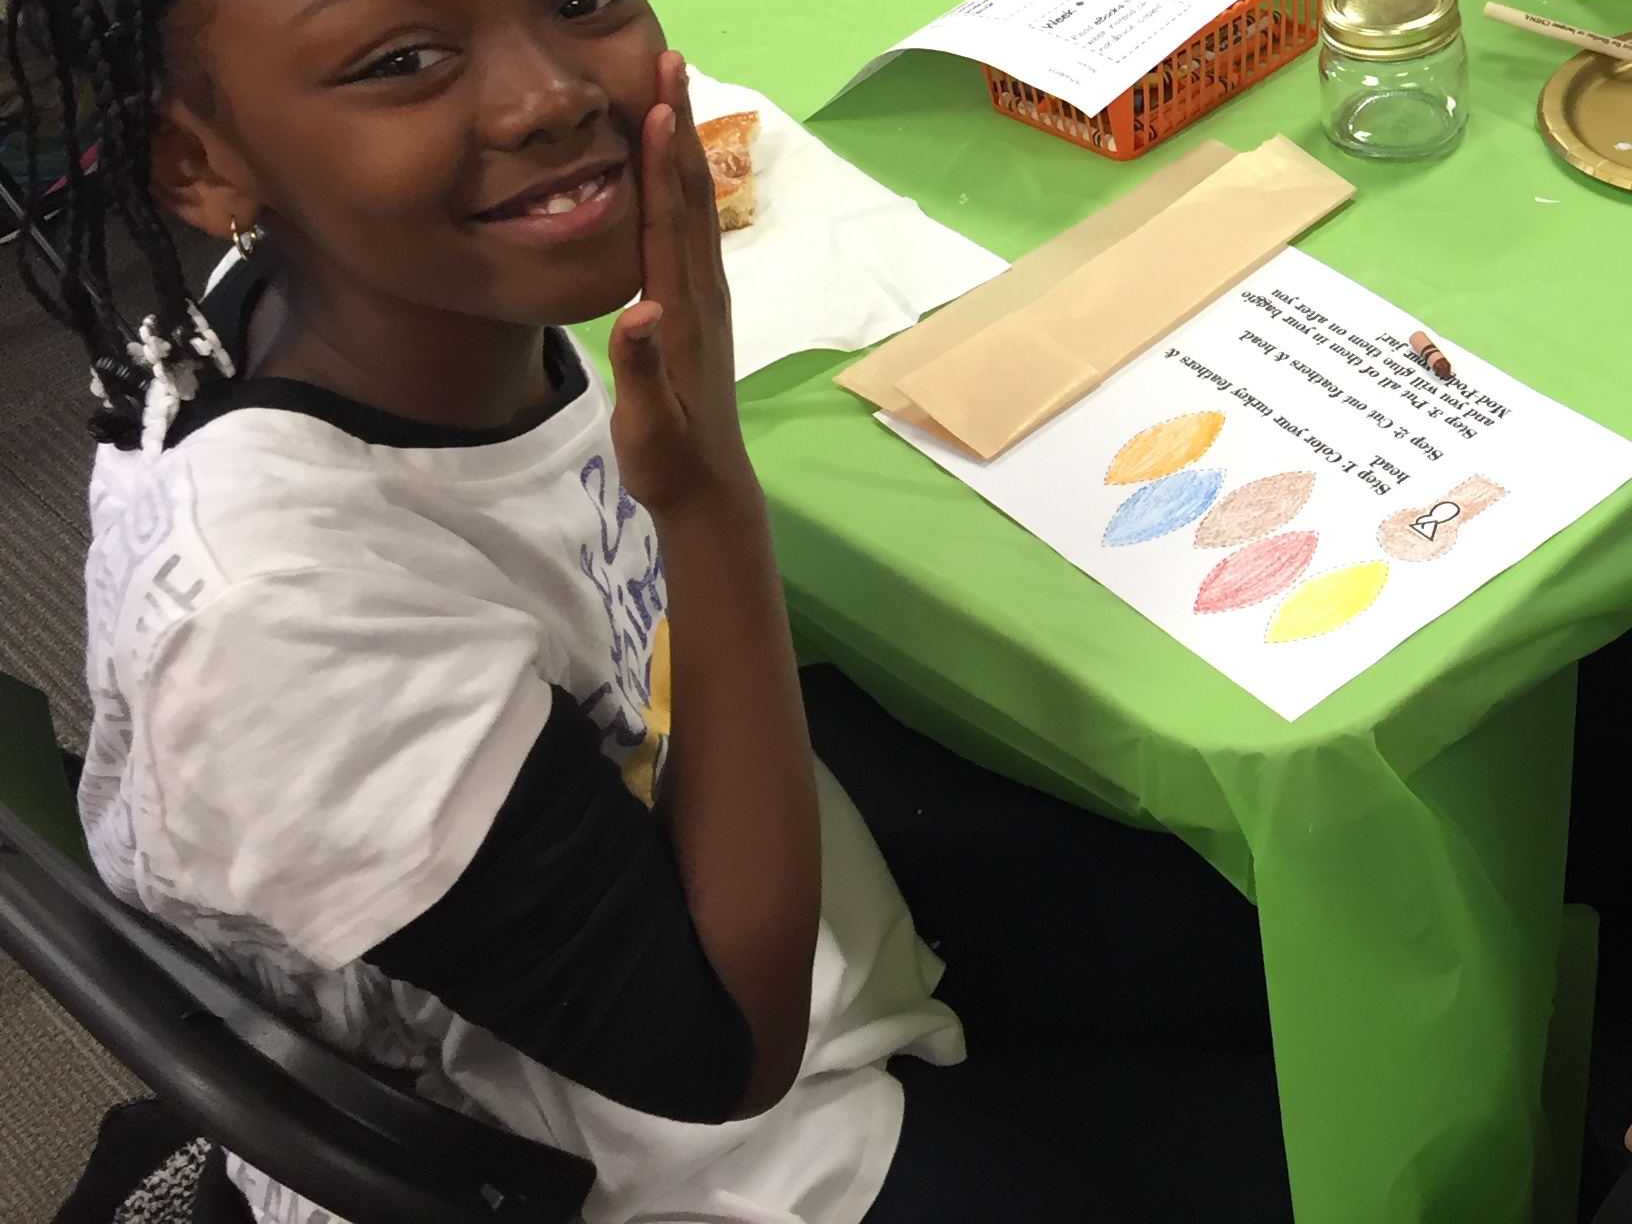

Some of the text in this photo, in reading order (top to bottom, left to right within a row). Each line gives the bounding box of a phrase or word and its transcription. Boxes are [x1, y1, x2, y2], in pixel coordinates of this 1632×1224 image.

[1043, 9, 1075, 29] Week
[1374, 332, 1410, 353] jar!
[1240, 291, 1478, 440] Step 3: Put all of them in your baggie
[1270, 288, 1496, 427] and you will glue them on after you
[1273, 351, 1291, 363] &
[1288, 359, 1345, 399] feathers
[1340, 395, 1368, 411] out
[1164, 347, 1392, 496] Step 1: Color your turkey feathers &
[1365, 409, 1394, 429] Cut
[1393, 426, 1411, 440] 2:
[1409, 436, 1444, 462] Step
[1368, 454, 1411, 485] head.
